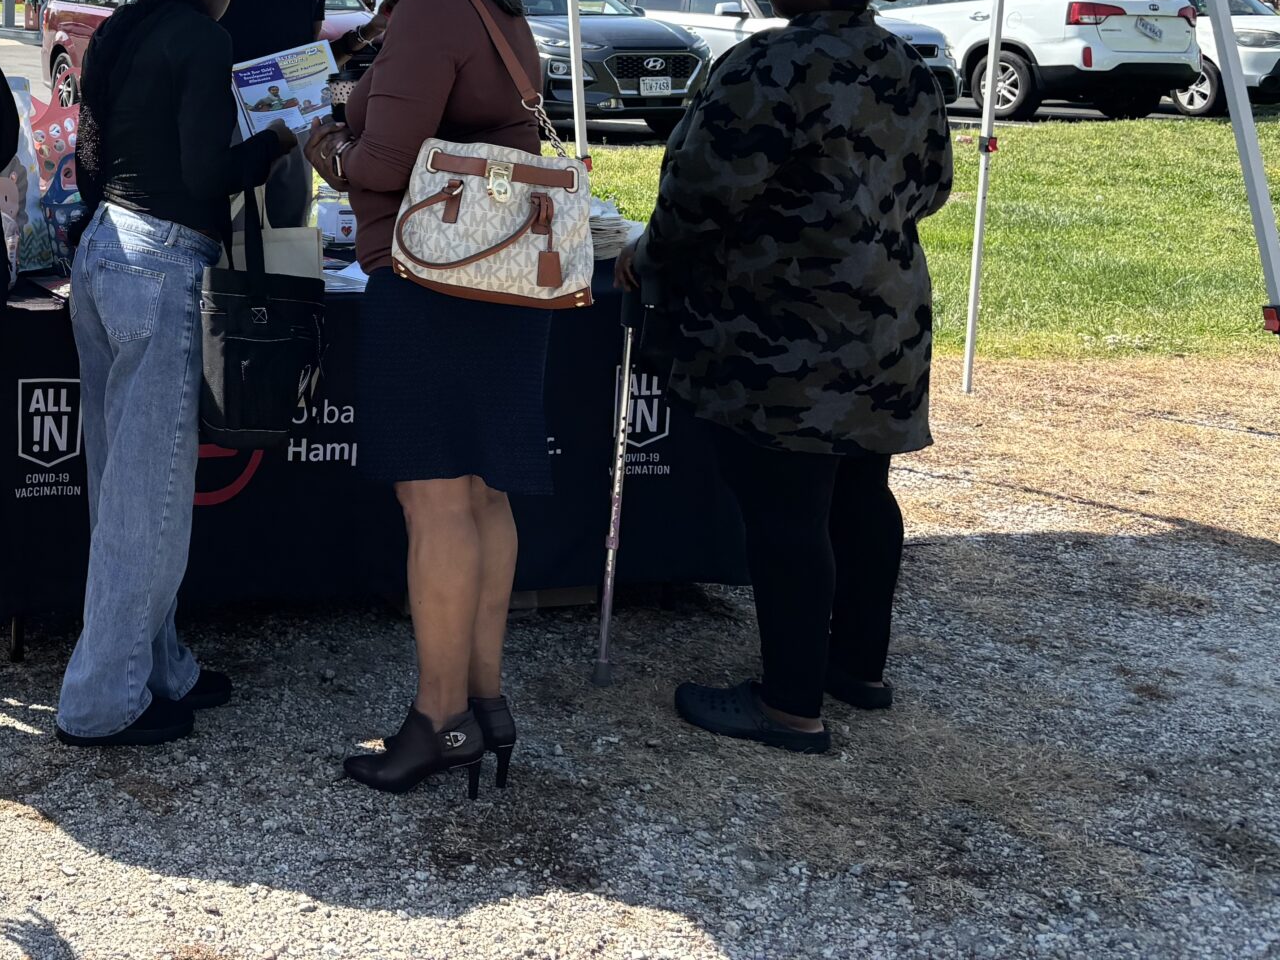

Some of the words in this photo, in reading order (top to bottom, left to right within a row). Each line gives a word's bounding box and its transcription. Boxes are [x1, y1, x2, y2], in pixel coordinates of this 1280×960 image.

[28, 388, 72, 413] ALL
[623, 452, 660, 463] OVID-19
[25, 472, 70, 484] COVID-19
[14, 485, 81, 499] VACCINATION
